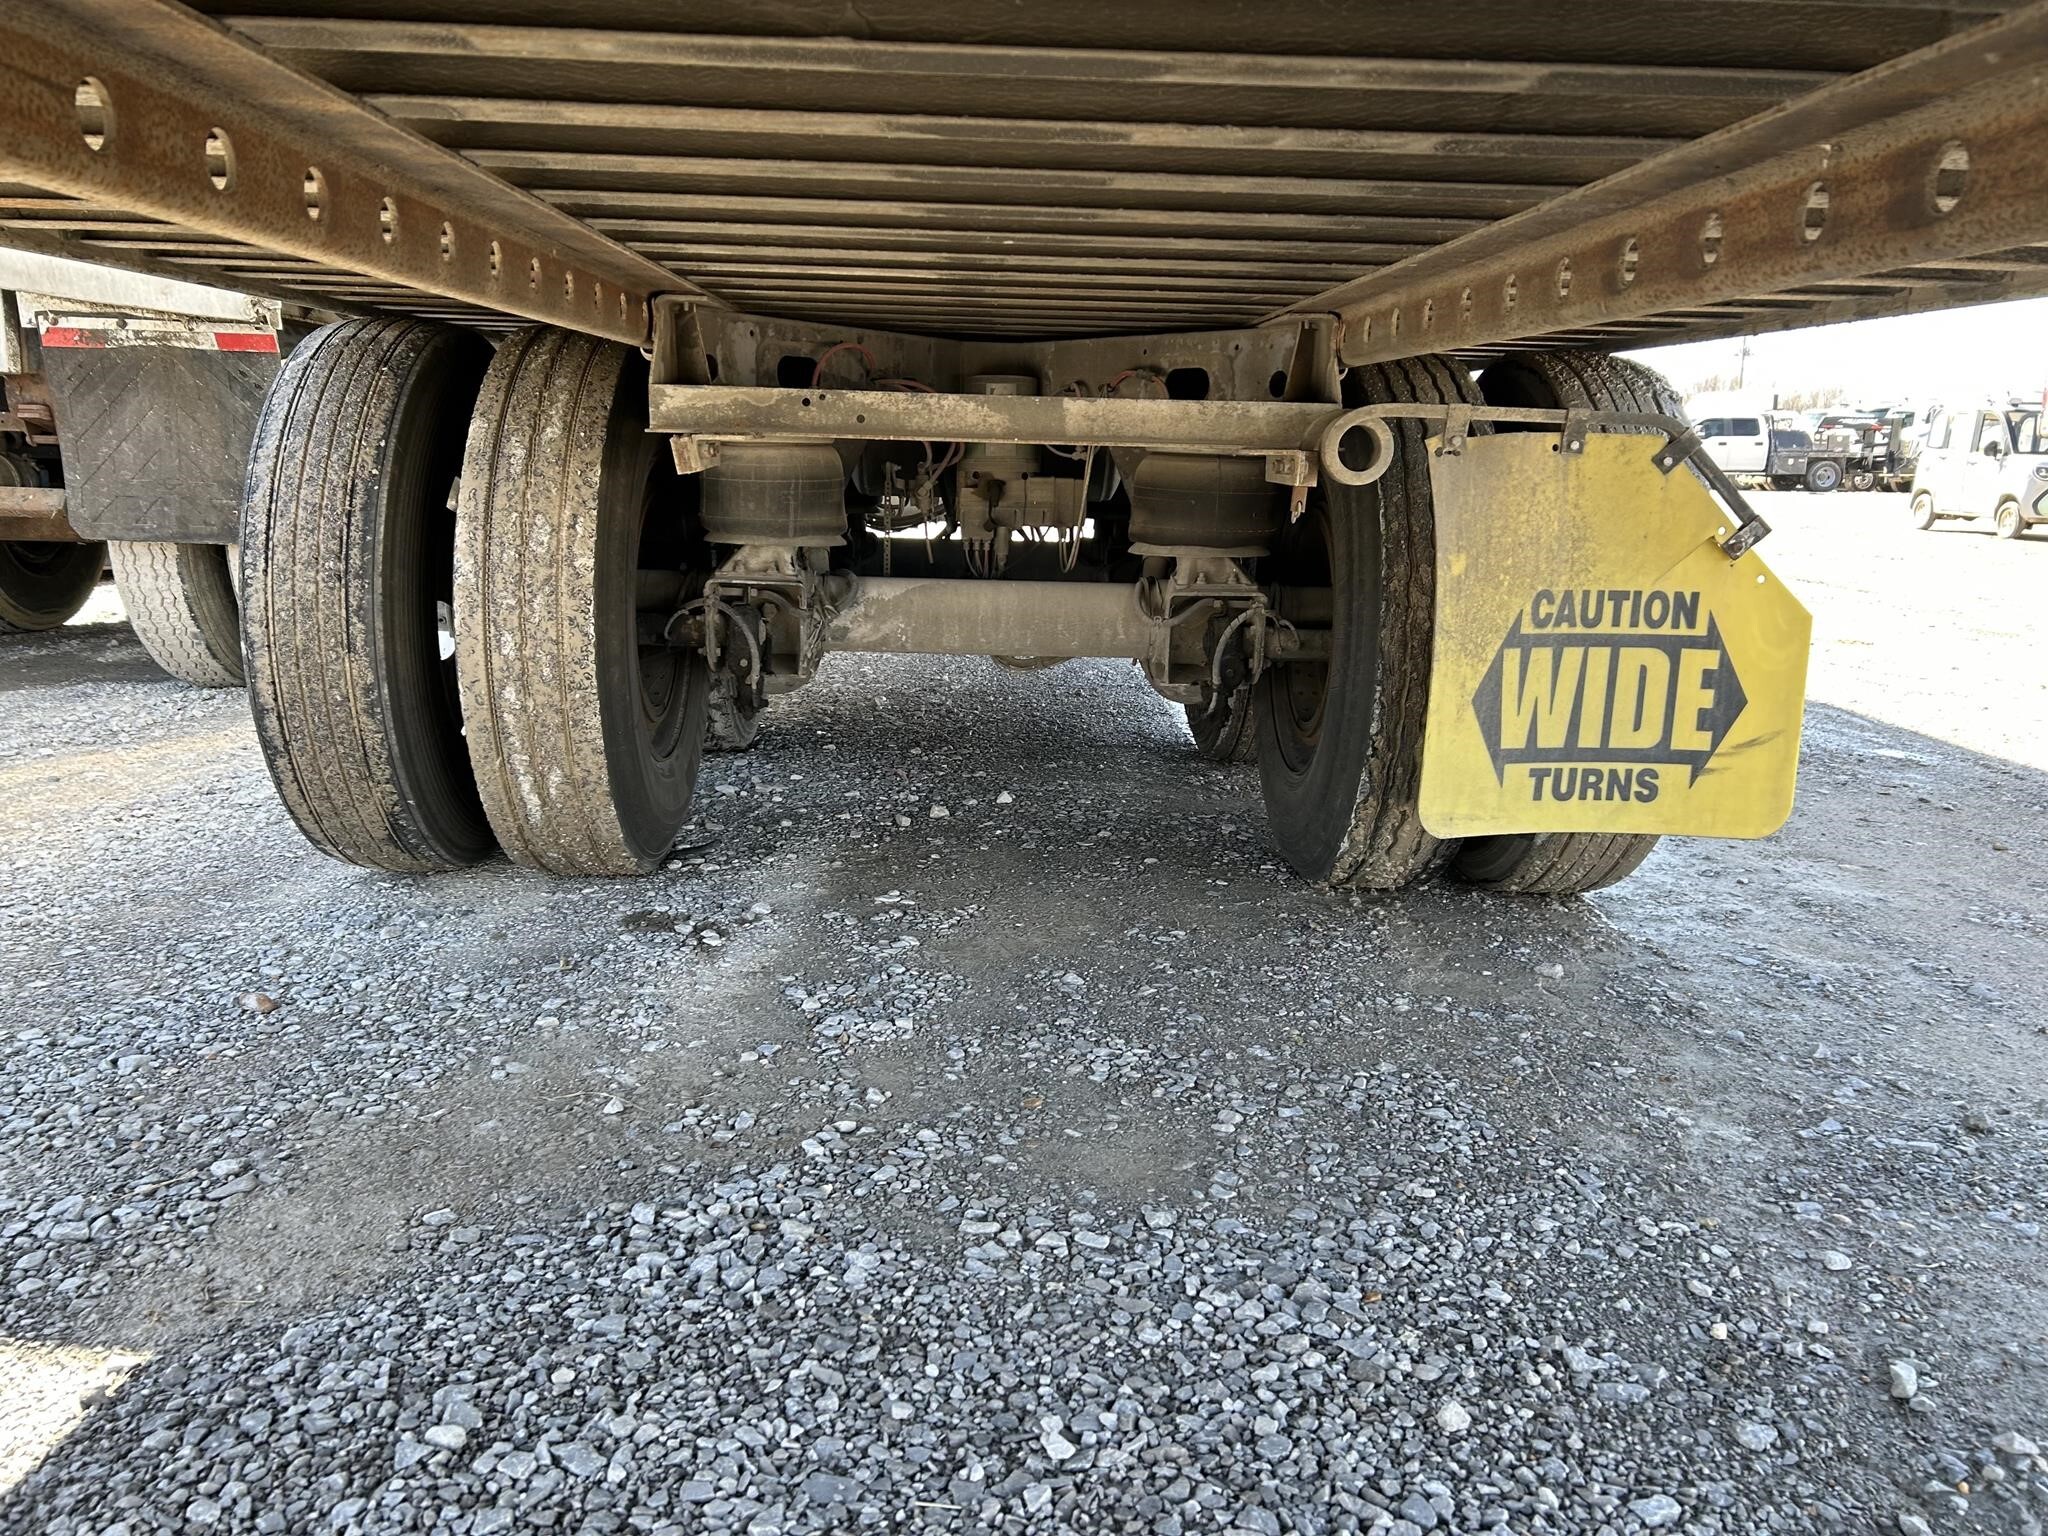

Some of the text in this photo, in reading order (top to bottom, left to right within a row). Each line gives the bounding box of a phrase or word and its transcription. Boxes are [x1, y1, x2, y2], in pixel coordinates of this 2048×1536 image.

[1530, 589, 1701, 630] CAUTION
[1500, 647, 1721, 751] WIDE
[1528, 768, 1660, 803] TURNS
